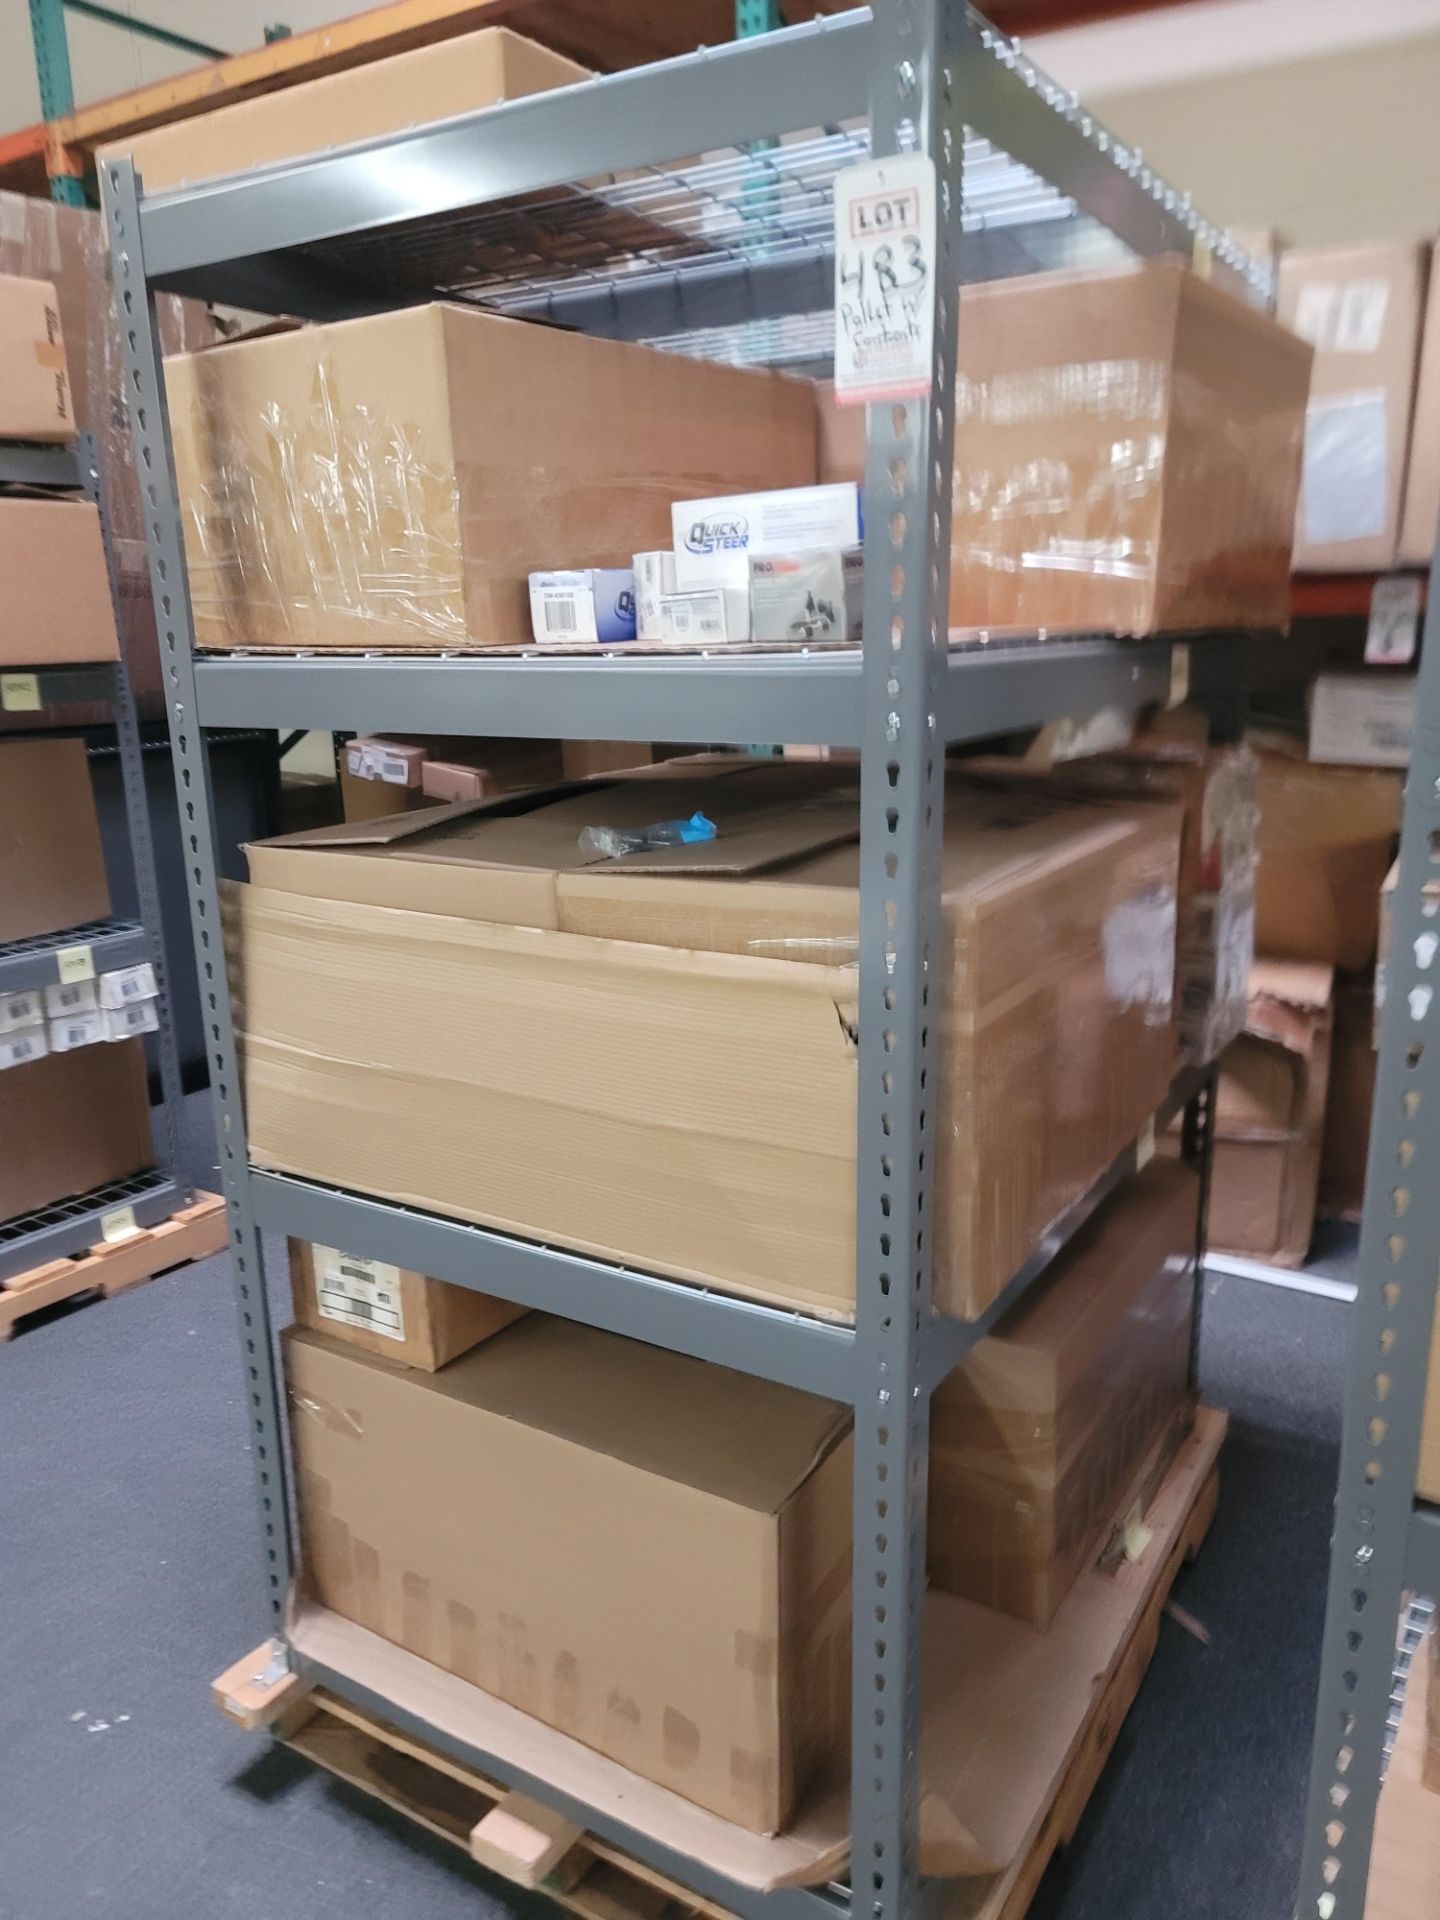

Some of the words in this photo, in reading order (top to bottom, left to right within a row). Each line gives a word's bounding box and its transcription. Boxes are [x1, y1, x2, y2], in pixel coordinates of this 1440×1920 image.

[857, 197, 911, 229] LOT
[840, 234, 928, 298] 483
[689, 521, 741, 545] QUICK
[702, 533, 749, 555] STEER
